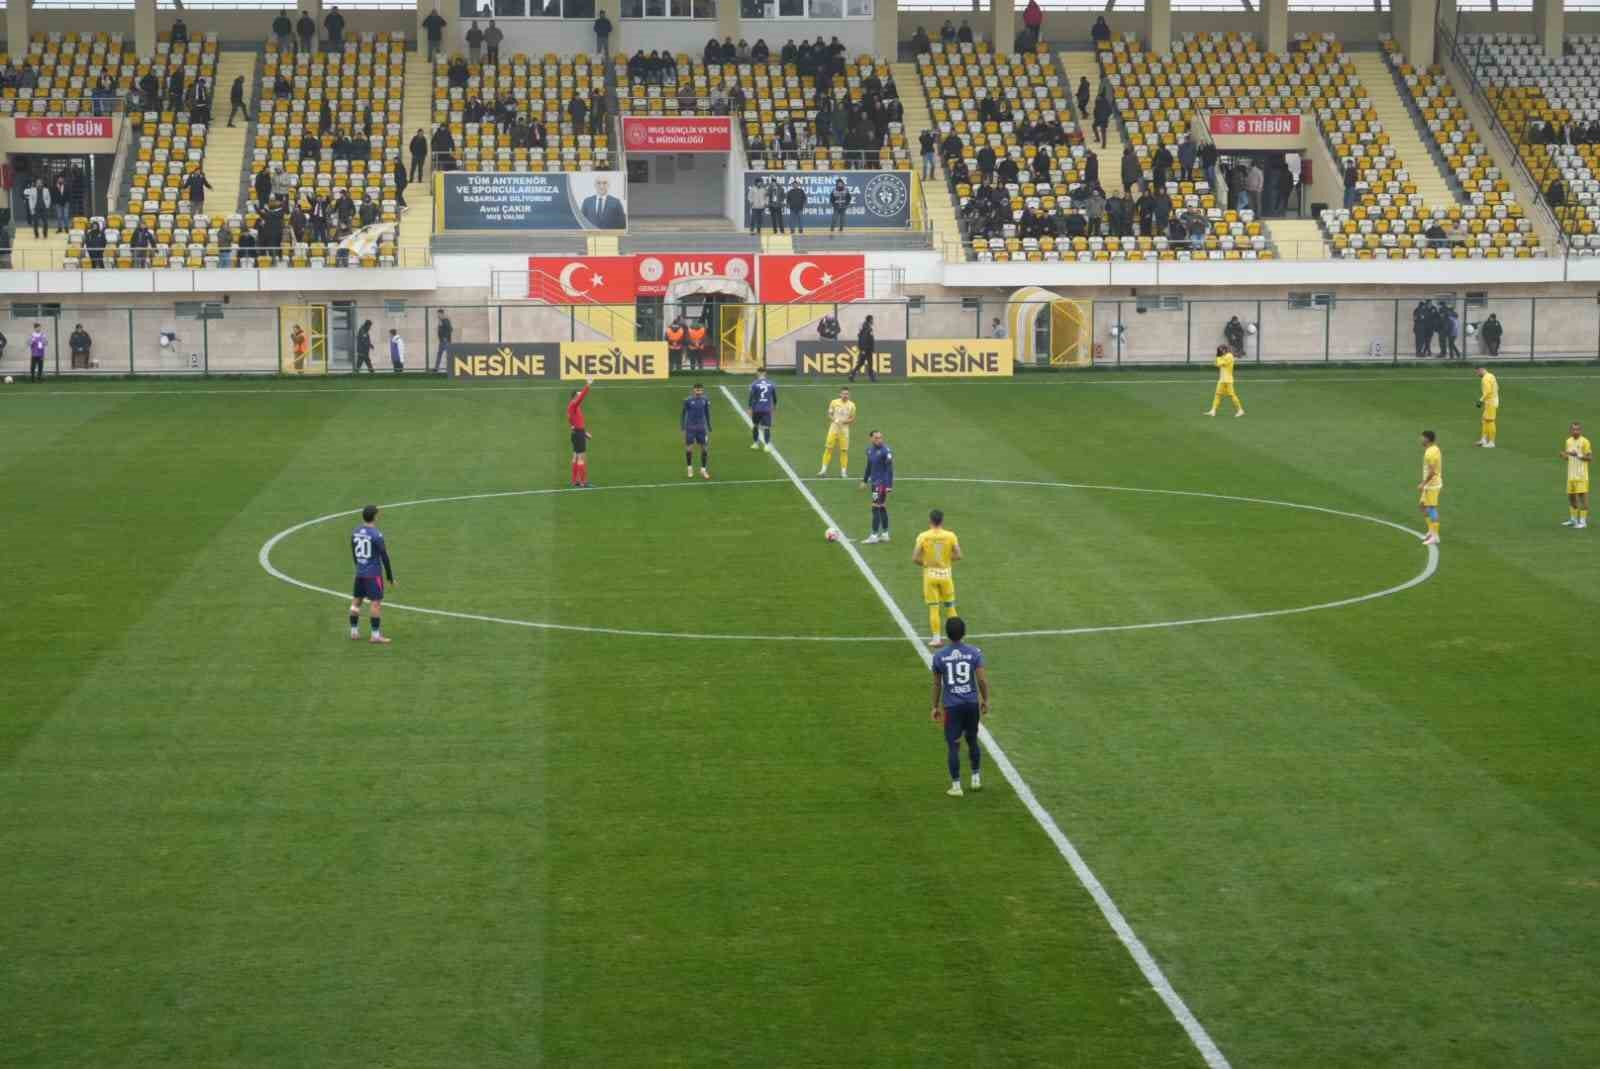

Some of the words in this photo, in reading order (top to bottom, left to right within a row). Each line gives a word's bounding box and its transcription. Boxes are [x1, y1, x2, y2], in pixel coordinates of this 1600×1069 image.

[46, 122, 55, 136] C
[56, 119, 103, 136] TRİBÜN
[709, 126, 728, 134] SPOR
[1237, 119, 1246, 133] B
[1247, 117, 1291, 133] TRİBÜN
[468, 175, 490, 185] TÜM
[492, 175, 547, 185] ANTRENÖR
[456, 185, 471, 193] VE
[472, 185, 559, 194] SPORCULARIMIZA
[353, 536, 372, 559] 20
[945, 660, 970, 685] 19
